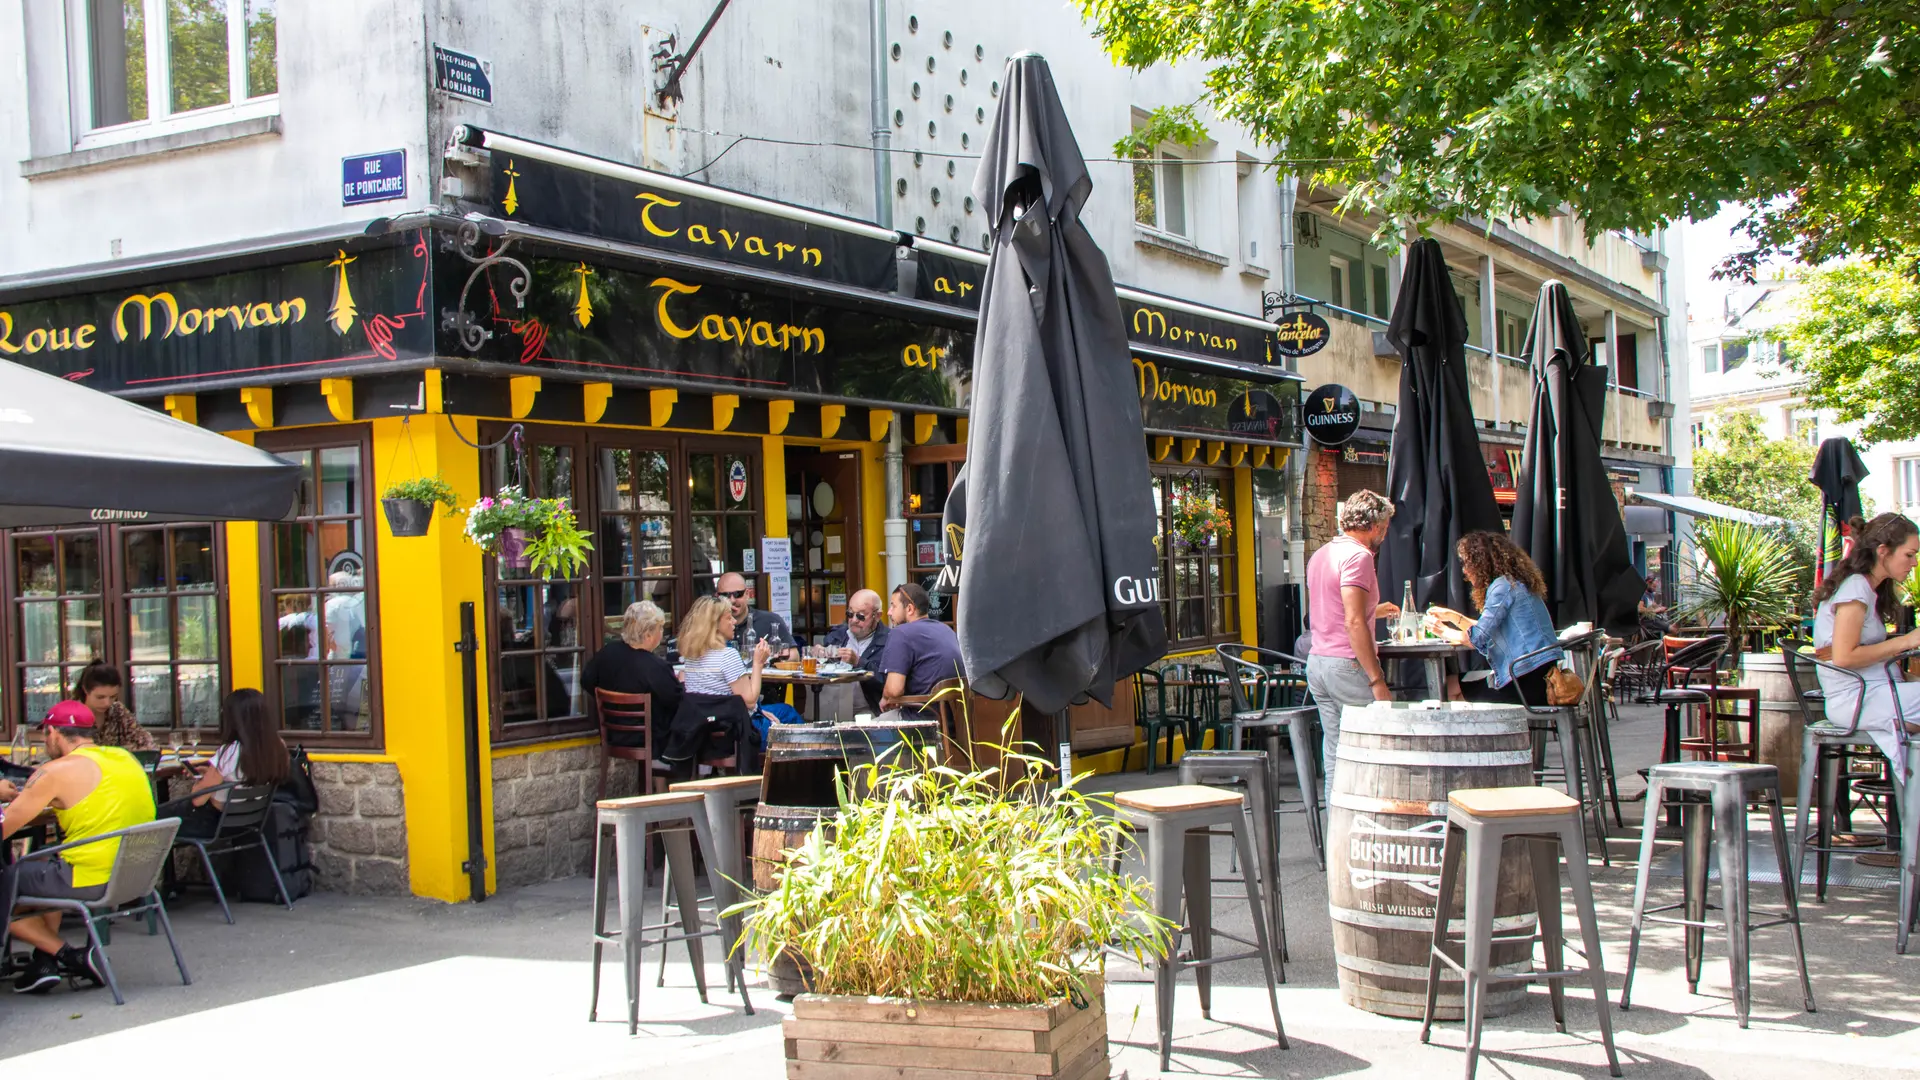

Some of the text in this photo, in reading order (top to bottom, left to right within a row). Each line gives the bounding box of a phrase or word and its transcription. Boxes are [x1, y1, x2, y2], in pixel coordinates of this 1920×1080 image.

[451, 69, 472, 83] POLIG
[443, 79, 485, 99] MONJARRET
[364, 160, 382, 175] RUE
[345, 175, 403, 197] DE PONTCARRÉ
[635, 193, 822, 267] Tavarn
[934, 276, 974, 298] ar
[115, 292, 307, 341] Morvan
[1133, 308, 1237, 351] Morvan
[650, 277, 1217, 408] Tavarn ar Morvan
[1308, 413, 1354, 426] GUINNESS
[1114, 575, 1160, 605] GUI
[1360, 899, 1384, 913] IRISH
